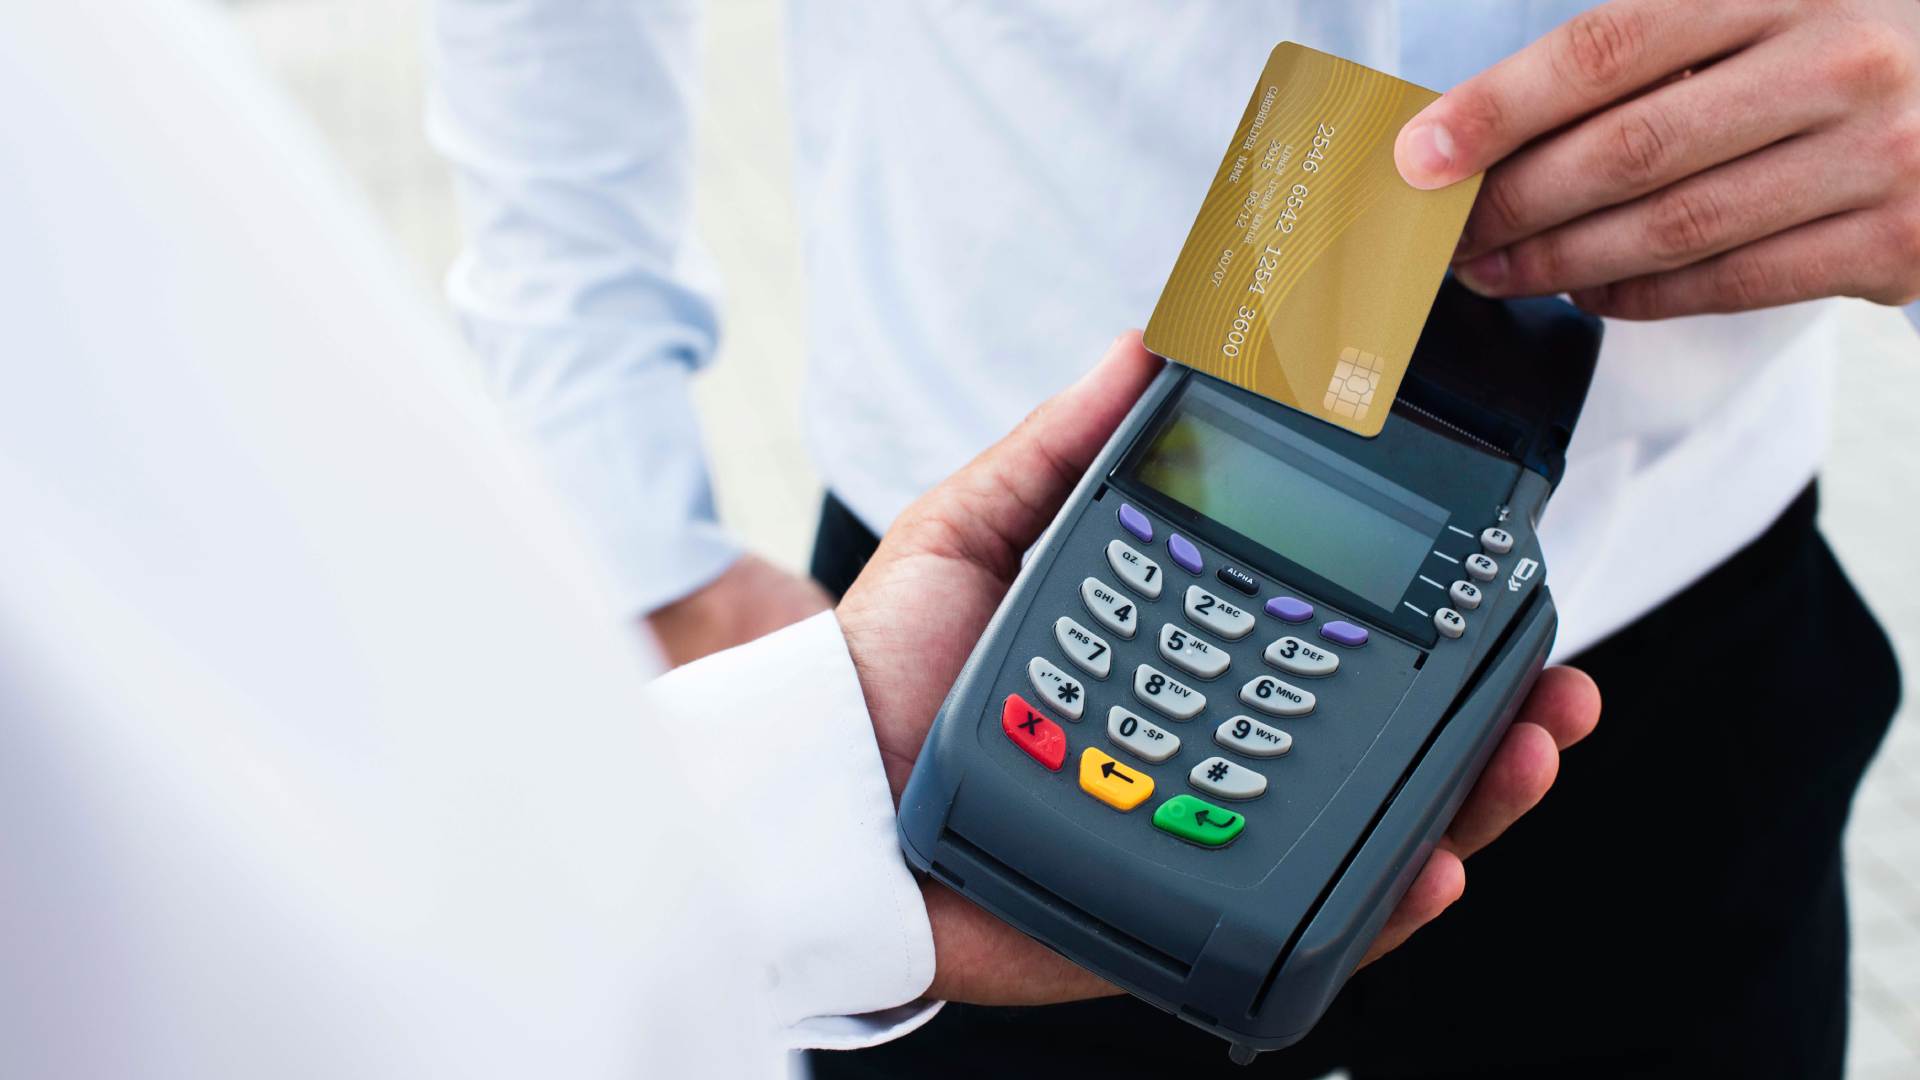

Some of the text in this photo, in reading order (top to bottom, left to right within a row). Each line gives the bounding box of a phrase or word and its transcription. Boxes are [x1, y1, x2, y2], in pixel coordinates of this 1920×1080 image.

[1229, 86, 1278, 184] CARDHOLDER NAME
[1212, 139, 1281, 288] 2015 08/12 00/07
[1222, 122, 1335, 358] 2546 6542 1254 3600
[1492, 530, 1507, 542] F1
[1144, 565, 1158, 583] 1
[1475, 556, 1491, 570] F2
[1227, 567, 1253, 585] ALPHA
[1460, 583, 1476, 597] F3
[1093, 588, 1132, 622] GHI 4
[1194, 594, 1241, 618] 2 ABC
[1444, 611, 1460, 625] F4
[1068, 627, 1107, 661] PRS 7
[1167, 630, 1208, 654] 5 JKL
[1280, 639, 1325, 662] 3 DEF
[1144, 673, 1191, 699] 8 TUV
[1255, 678, 1302, 703] 6 MNO
[1119, 716, 1138, 737] 0
[1231, 719, 1281, 745] 9 WXY
